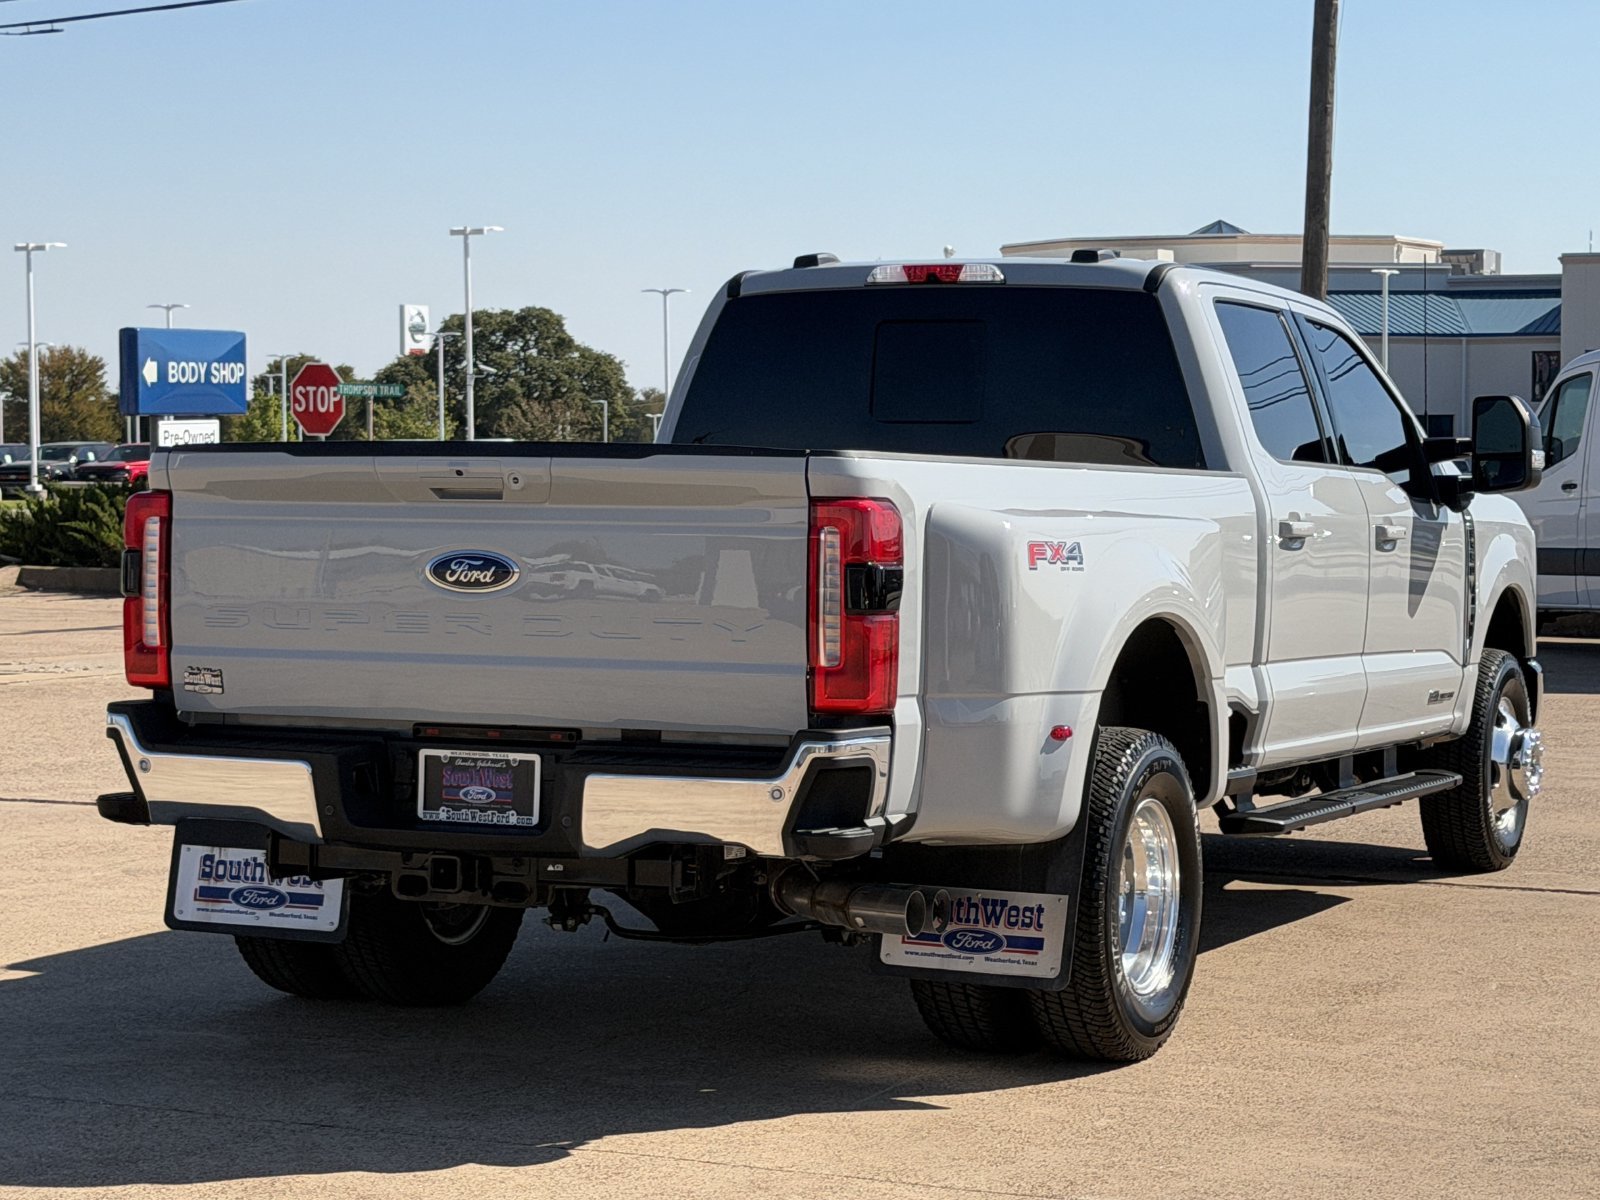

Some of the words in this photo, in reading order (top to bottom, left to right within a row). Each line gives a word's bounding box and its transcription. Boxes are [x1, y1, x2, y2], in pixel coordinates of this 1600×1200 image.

[168, 361, 207, 383] BODY
[211, 362, 244, 384] SHOP
[294, 386, 341, 413] STOP
[340, 384, 377, 395] THOMPSON
[380, 386, 402, 396] TRAIL
[163, 429, 215, 444] Pre-Owned
[1027, 541, 1084, 571] FX4
[445, 558, 496, 583] Ford
[203, 604, 492, 636] SUPER
[467, 788, 488, 800] Ford
[240, 889, 280, 906] Ford
[952, 931, 996, 950] Ford
